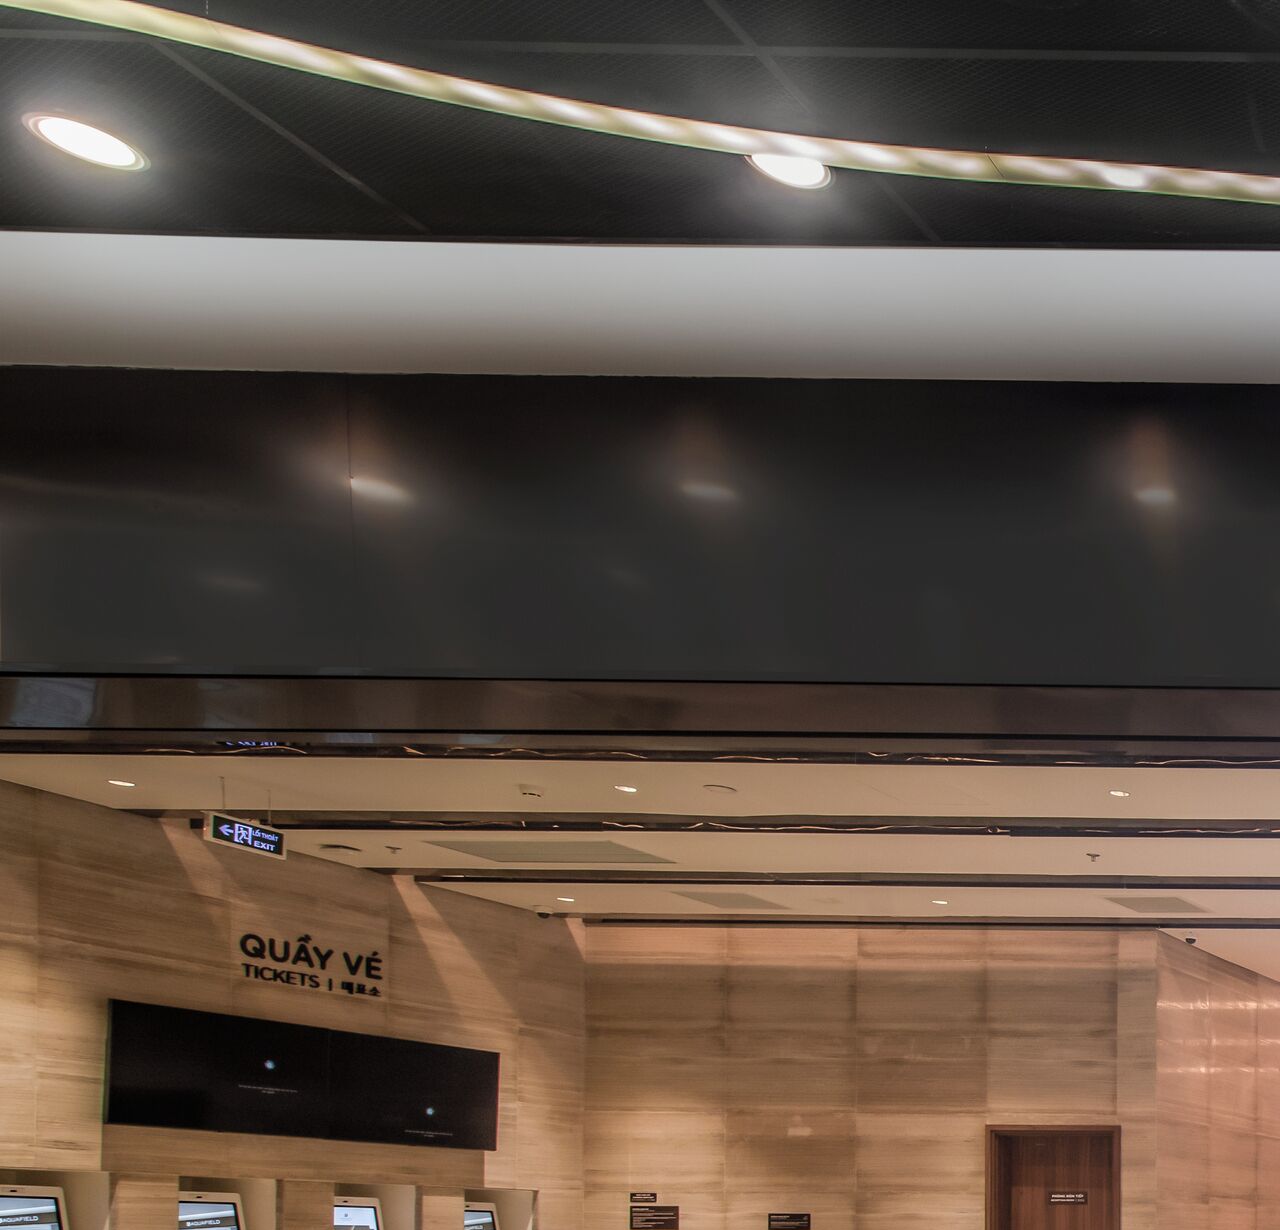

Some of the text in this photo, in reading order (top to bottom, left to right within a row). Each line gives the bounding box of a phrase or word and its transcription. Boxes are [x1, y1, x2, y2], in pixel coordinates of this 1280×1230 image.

[253, 840, 276, 852] EXIT
[241, 962, 321, 988] TICKETS
[342, 951, 383, 980] VÉ
